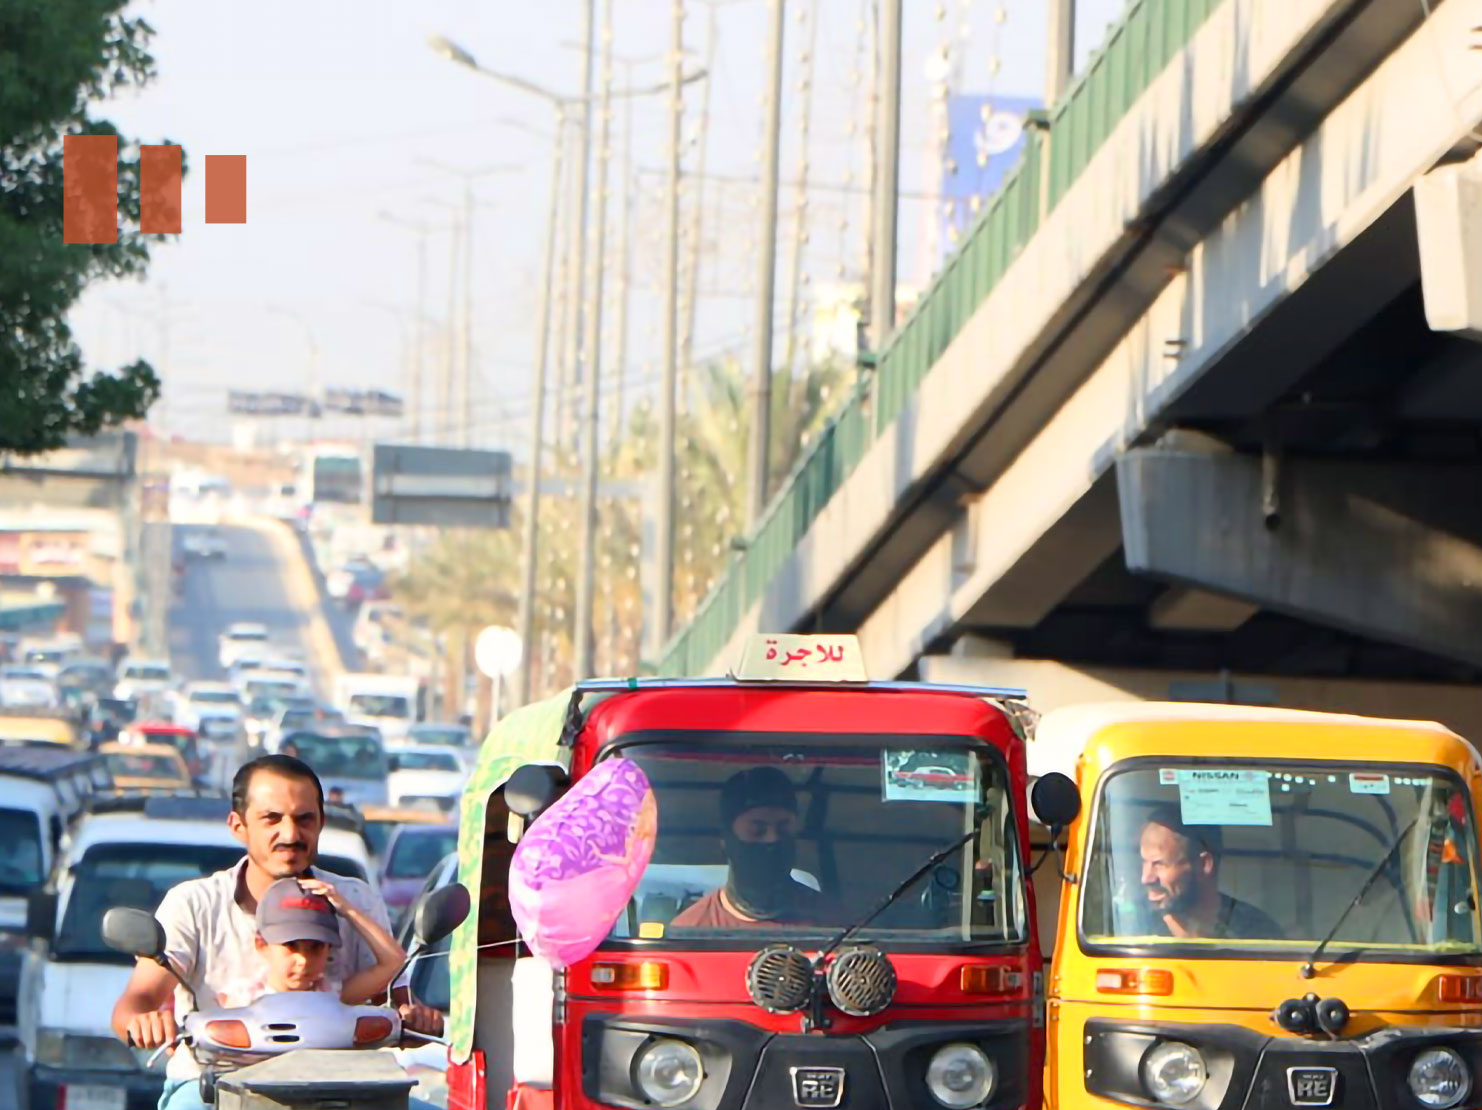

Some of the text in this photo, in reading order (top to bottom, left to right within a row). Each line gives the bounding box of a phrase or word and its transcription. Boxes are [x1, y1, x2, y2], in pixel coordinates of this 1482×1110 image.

[765, 639, 845, 668] للاجرة
[1192, 770, 1240, 780] NISSAN
[1297, 1079, 1328, 1097] RE
